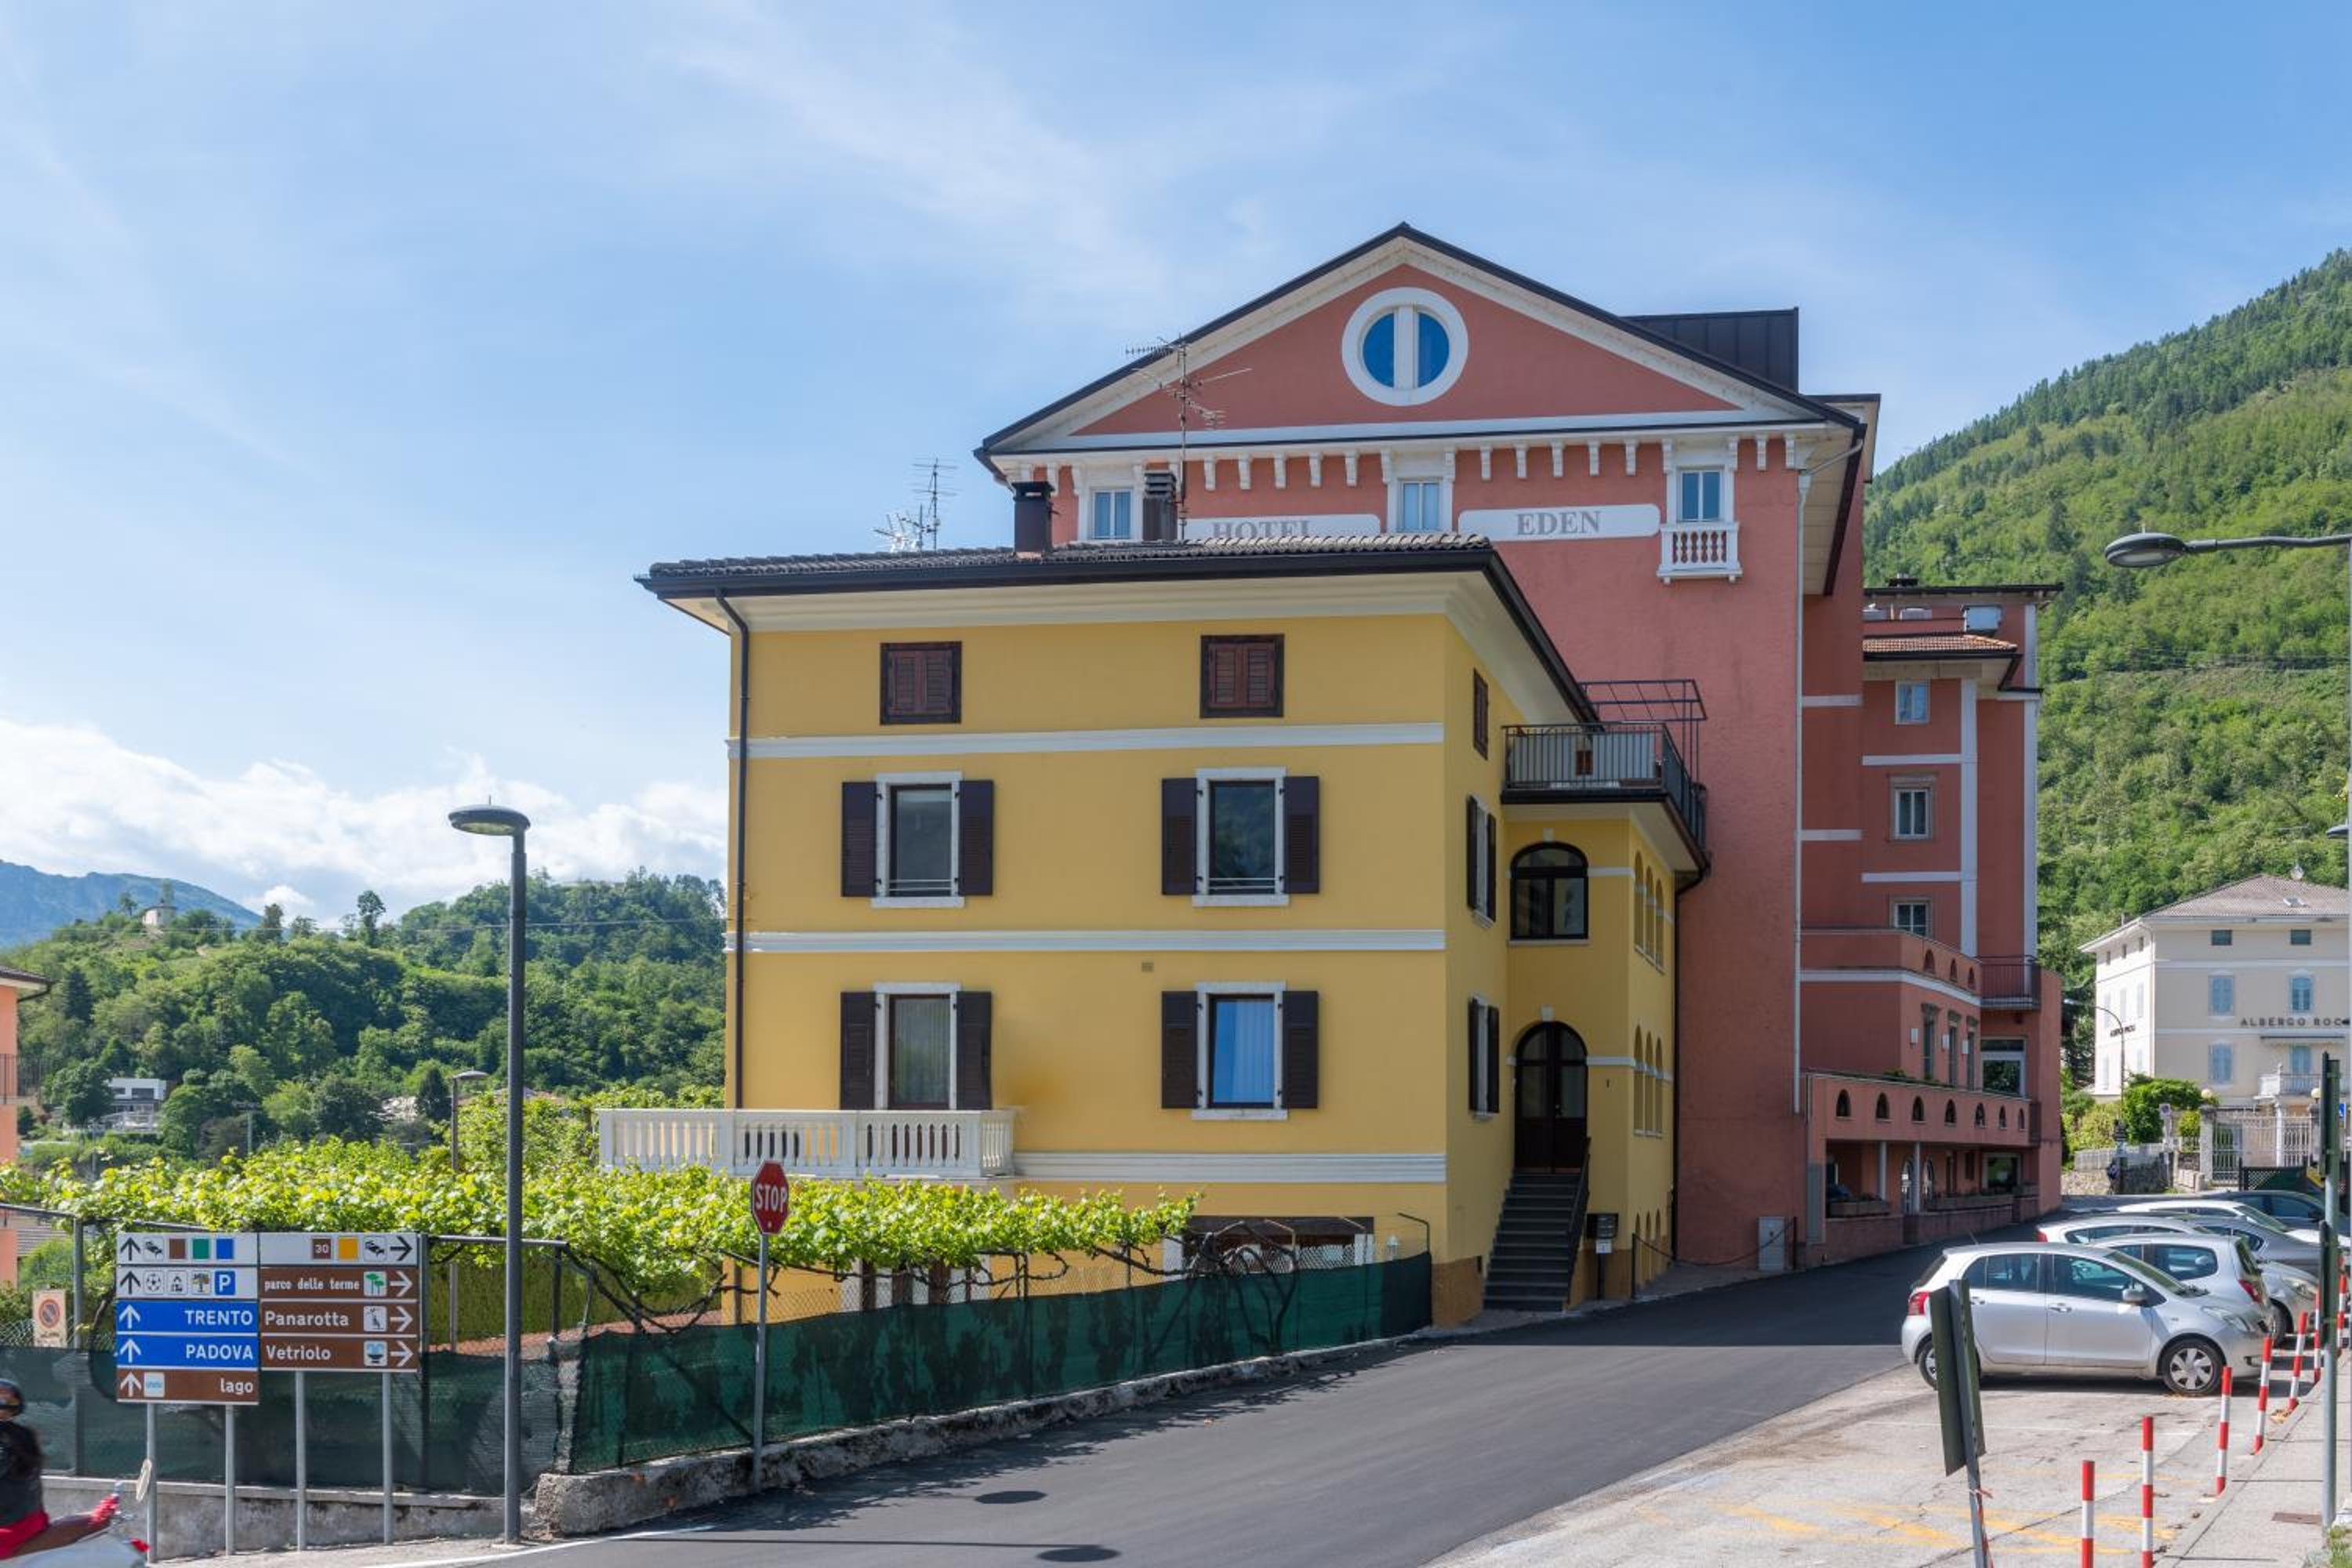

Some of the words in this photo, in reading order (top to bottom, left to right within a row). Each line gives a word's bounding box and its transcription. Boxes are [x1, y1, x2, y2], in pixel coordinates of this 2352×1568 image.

[1516, 511, 1602, 535] EDEN
[2241, 1018, 2306, 1026] ALBERGO
[2314, 1018, 2342, 1026] ROC
[755, 1183, 787, 1213] STOP
[314, 1244, 329, 1254] 30
[218, 1274, 231, 1290] P
[264, 1279, 292, 1292] parco
[297, 1277, 324, 1290] delle
[329, 1277, 360, 1290] terme
[184, 1310, 253, 1326] TRENTO
[265, 1311, 349, 1327] Panarotta
[185, 1345, 253, 1360] PADOVA
[266, 1344, 331, 1361] Vetriolo
[220, 1377, 254, 1396] lago
